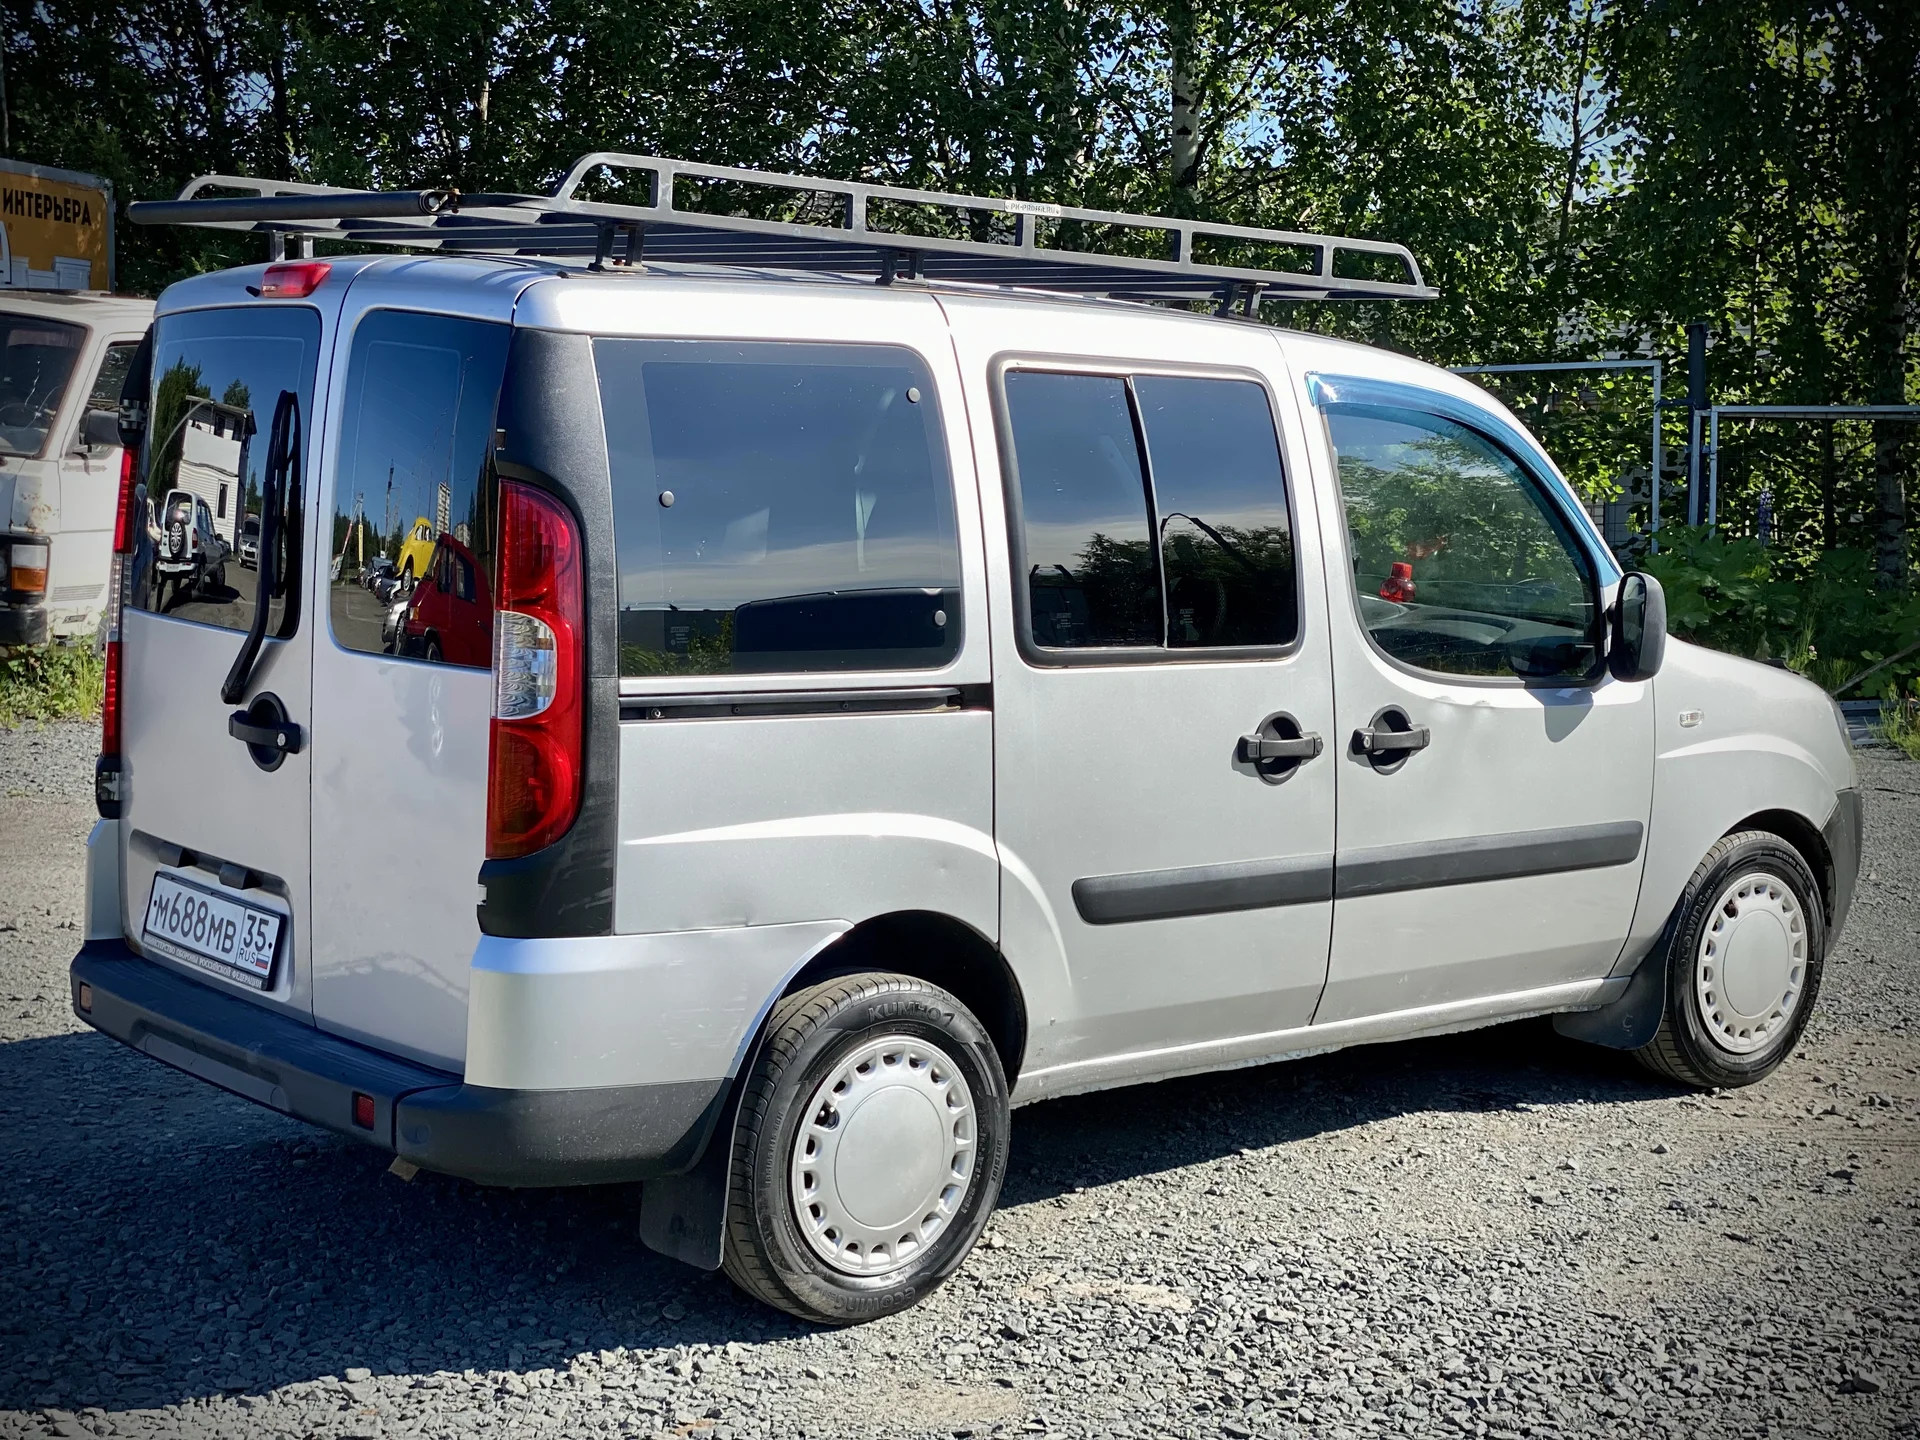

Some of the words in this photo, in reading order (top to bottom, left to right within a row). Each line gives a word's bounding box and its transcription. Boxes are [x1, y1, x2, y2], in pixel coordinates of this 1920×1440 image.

[3, 188, 92, 226] ИНТЕРЬЕРА
[243, 914, 269, 952] 35
[238, 947, 256, 965] RUS
